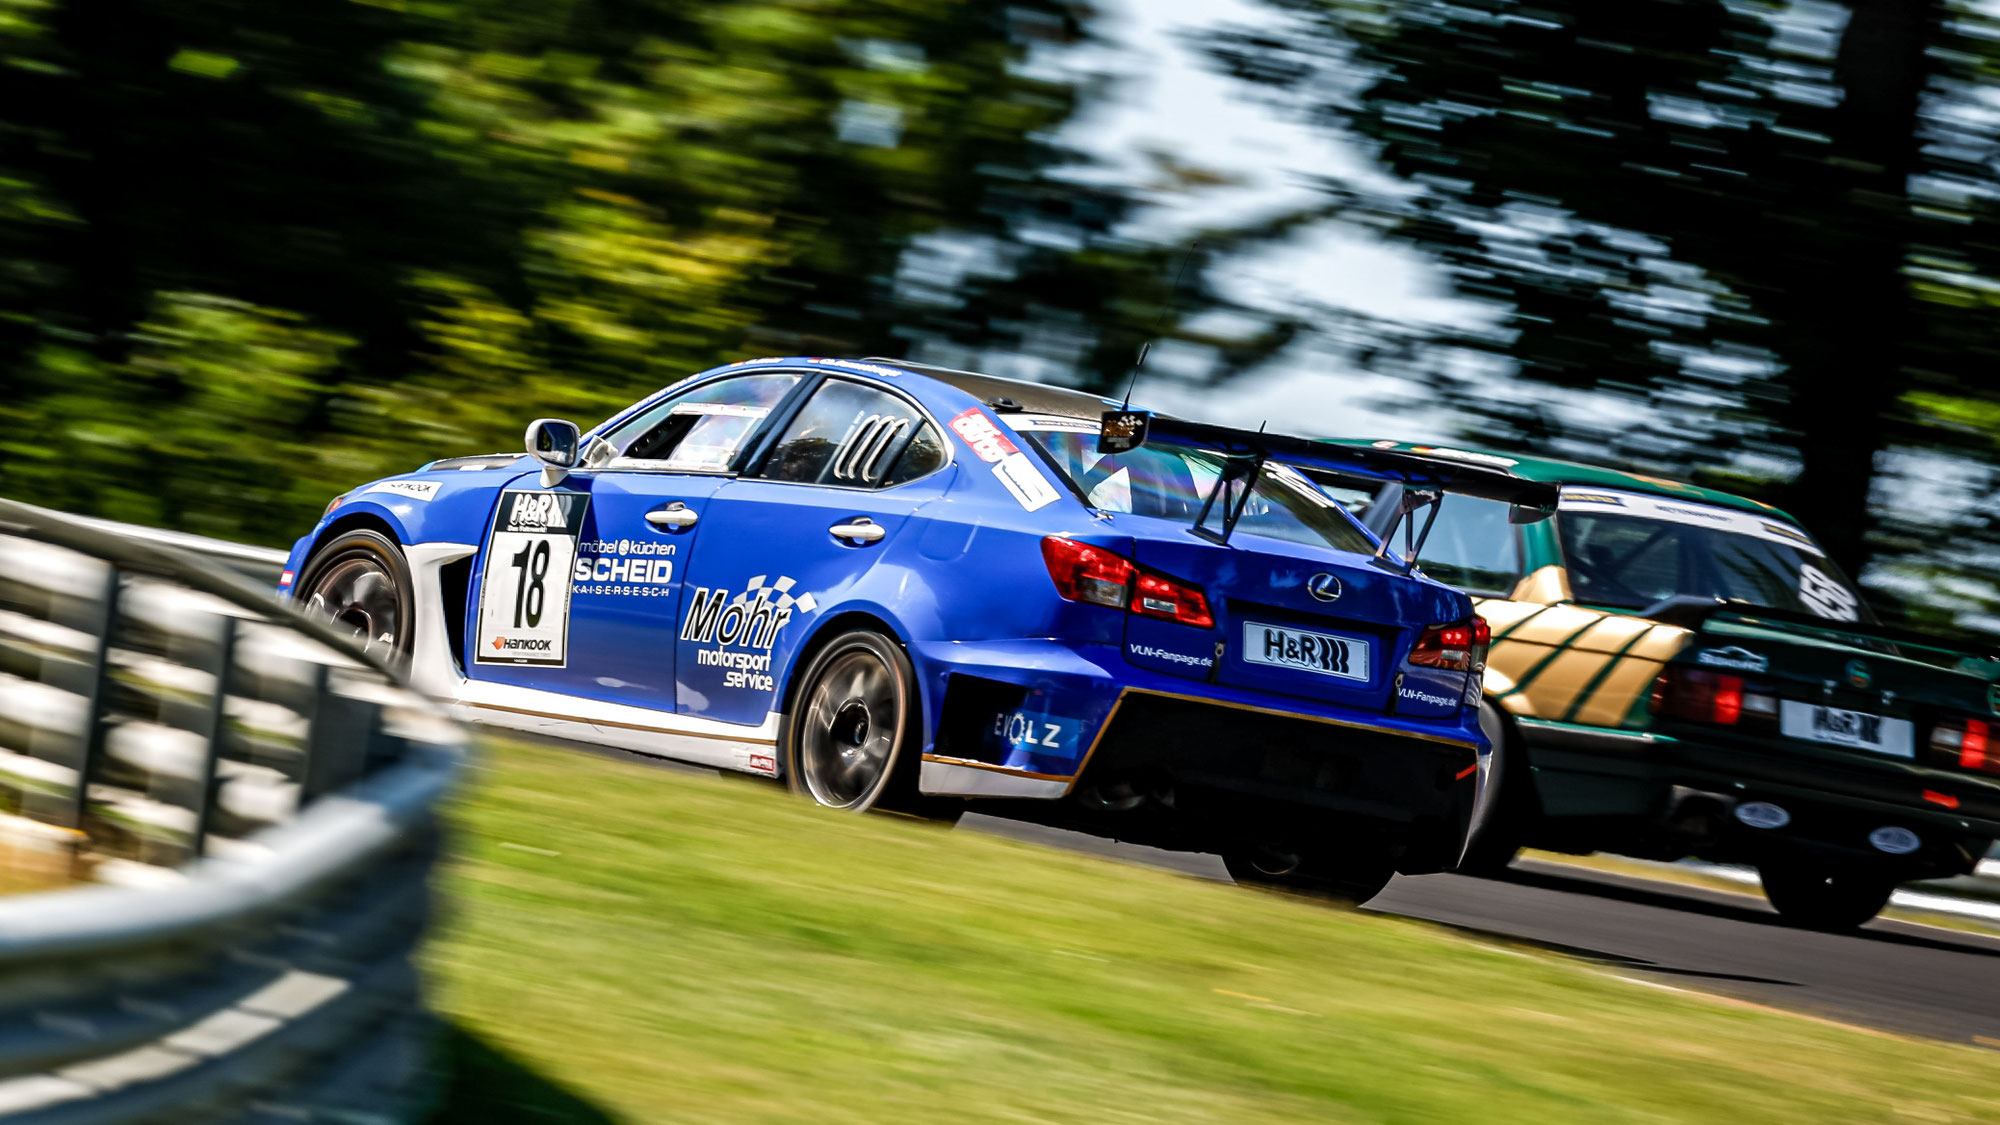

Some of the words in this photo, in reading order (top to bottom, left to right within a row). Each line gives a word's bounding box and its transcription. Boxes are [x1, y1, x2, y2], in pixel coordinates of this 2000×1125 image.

[510, 493, 551, 527] H&R
[579, 539, 618, 554] möbel
[629, 540, 676, 556] küchen
[512, 540, 550, 628] 18
[574, 557, 673, 584] SCHEID
[680, 586, 793, 650] Mohr
[697, 645, 772, 672] motorsport
[1130, 643, 1214, 667] VLN-Fanpage.de
[1264, 628, 1321, 669] H&R
[723, 669, 774, 692] service
[1397, 687, 1458, 707] VLN-Fanpage.de
